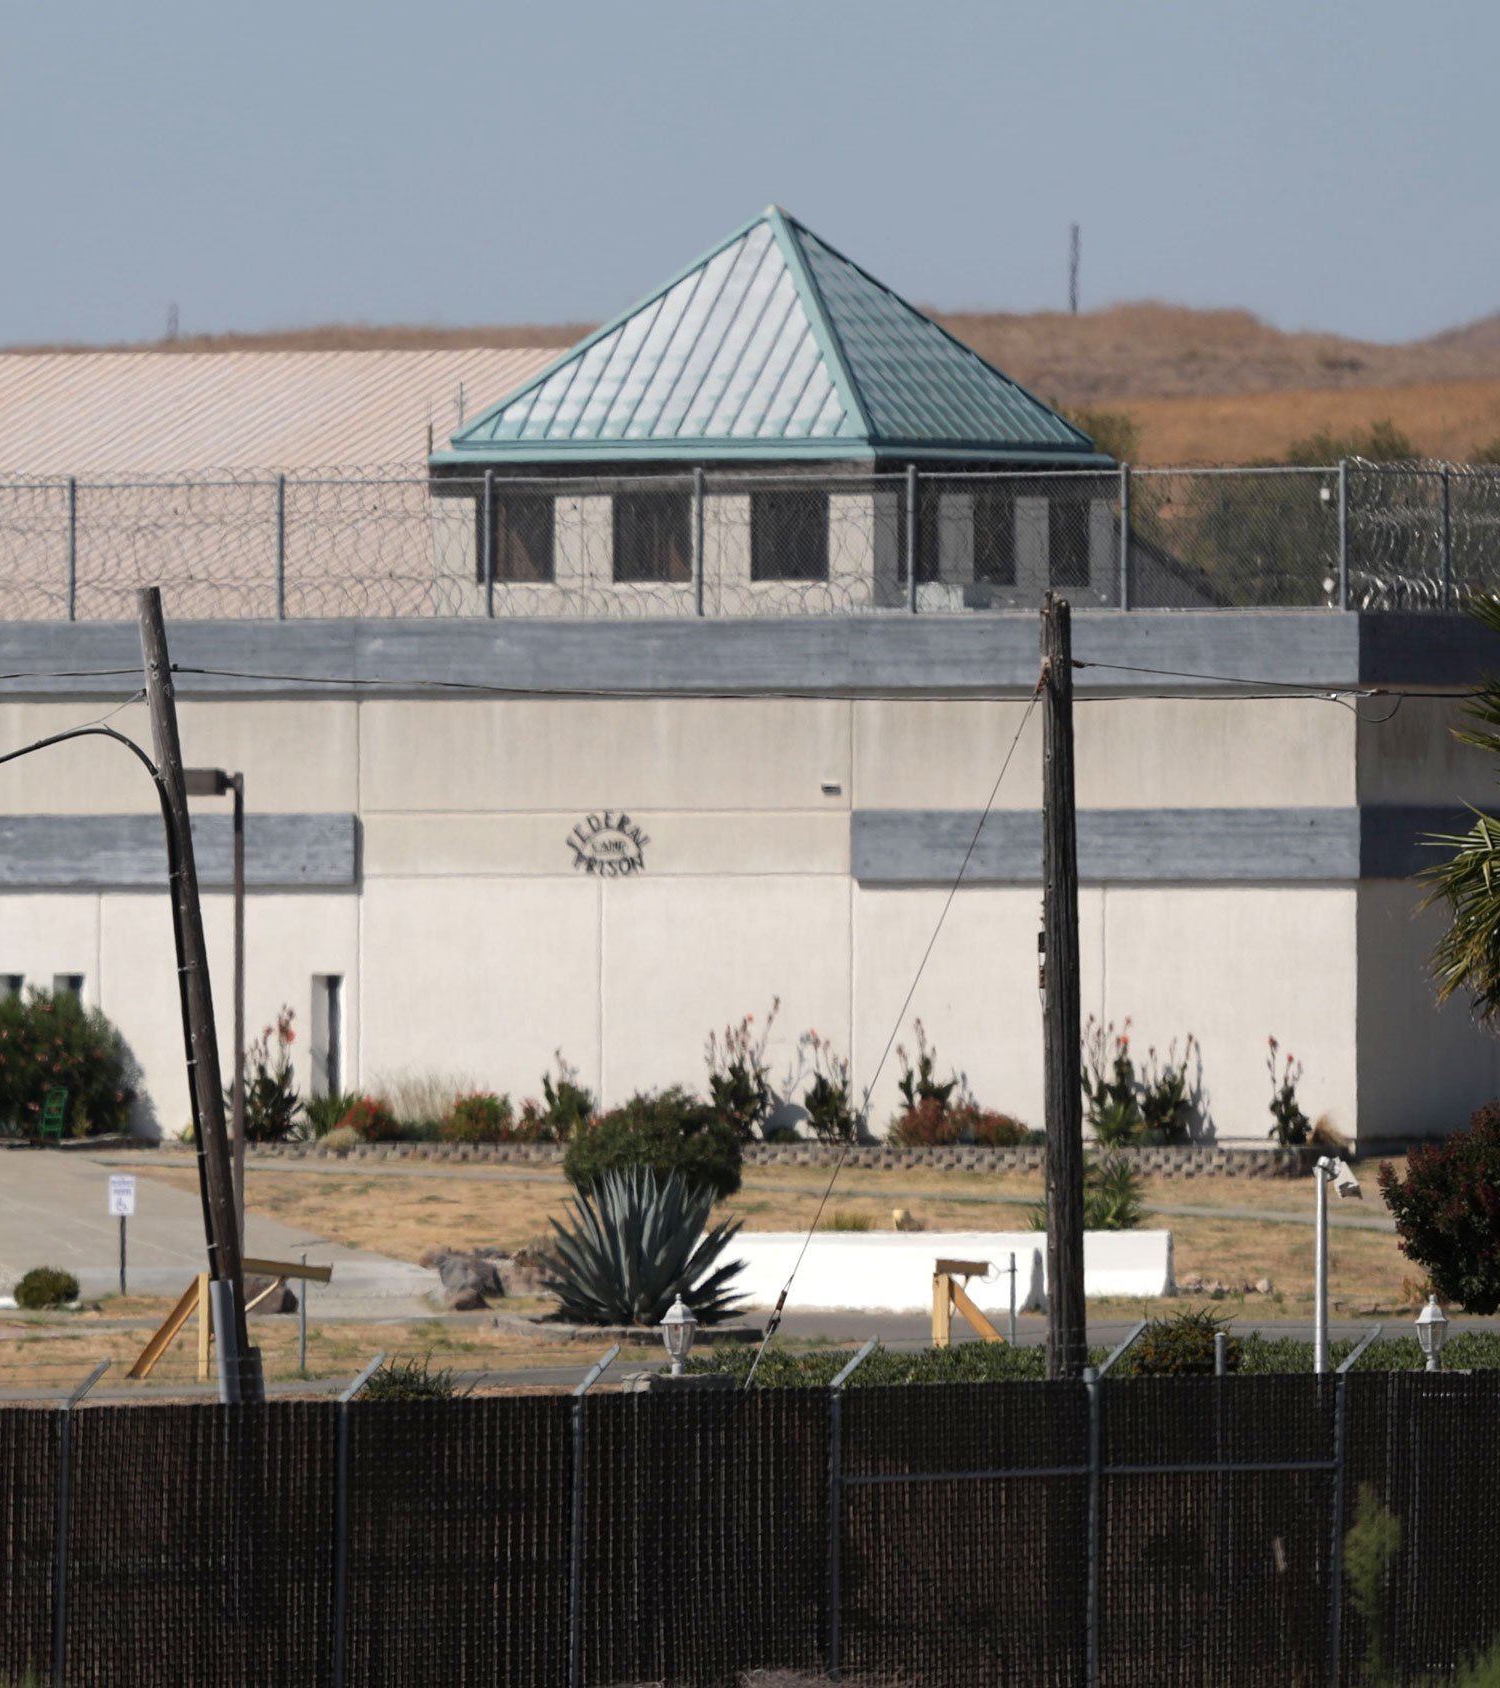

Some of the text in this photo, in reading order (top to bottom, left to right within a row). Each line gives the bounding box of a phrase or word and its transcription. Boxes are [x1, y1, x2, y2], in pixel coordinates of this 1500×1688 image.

[566, 809, 651, 850] FEDERAL
[592, 839, 626, 852] CAMP
[573, 850, 645, 877] PRISON
